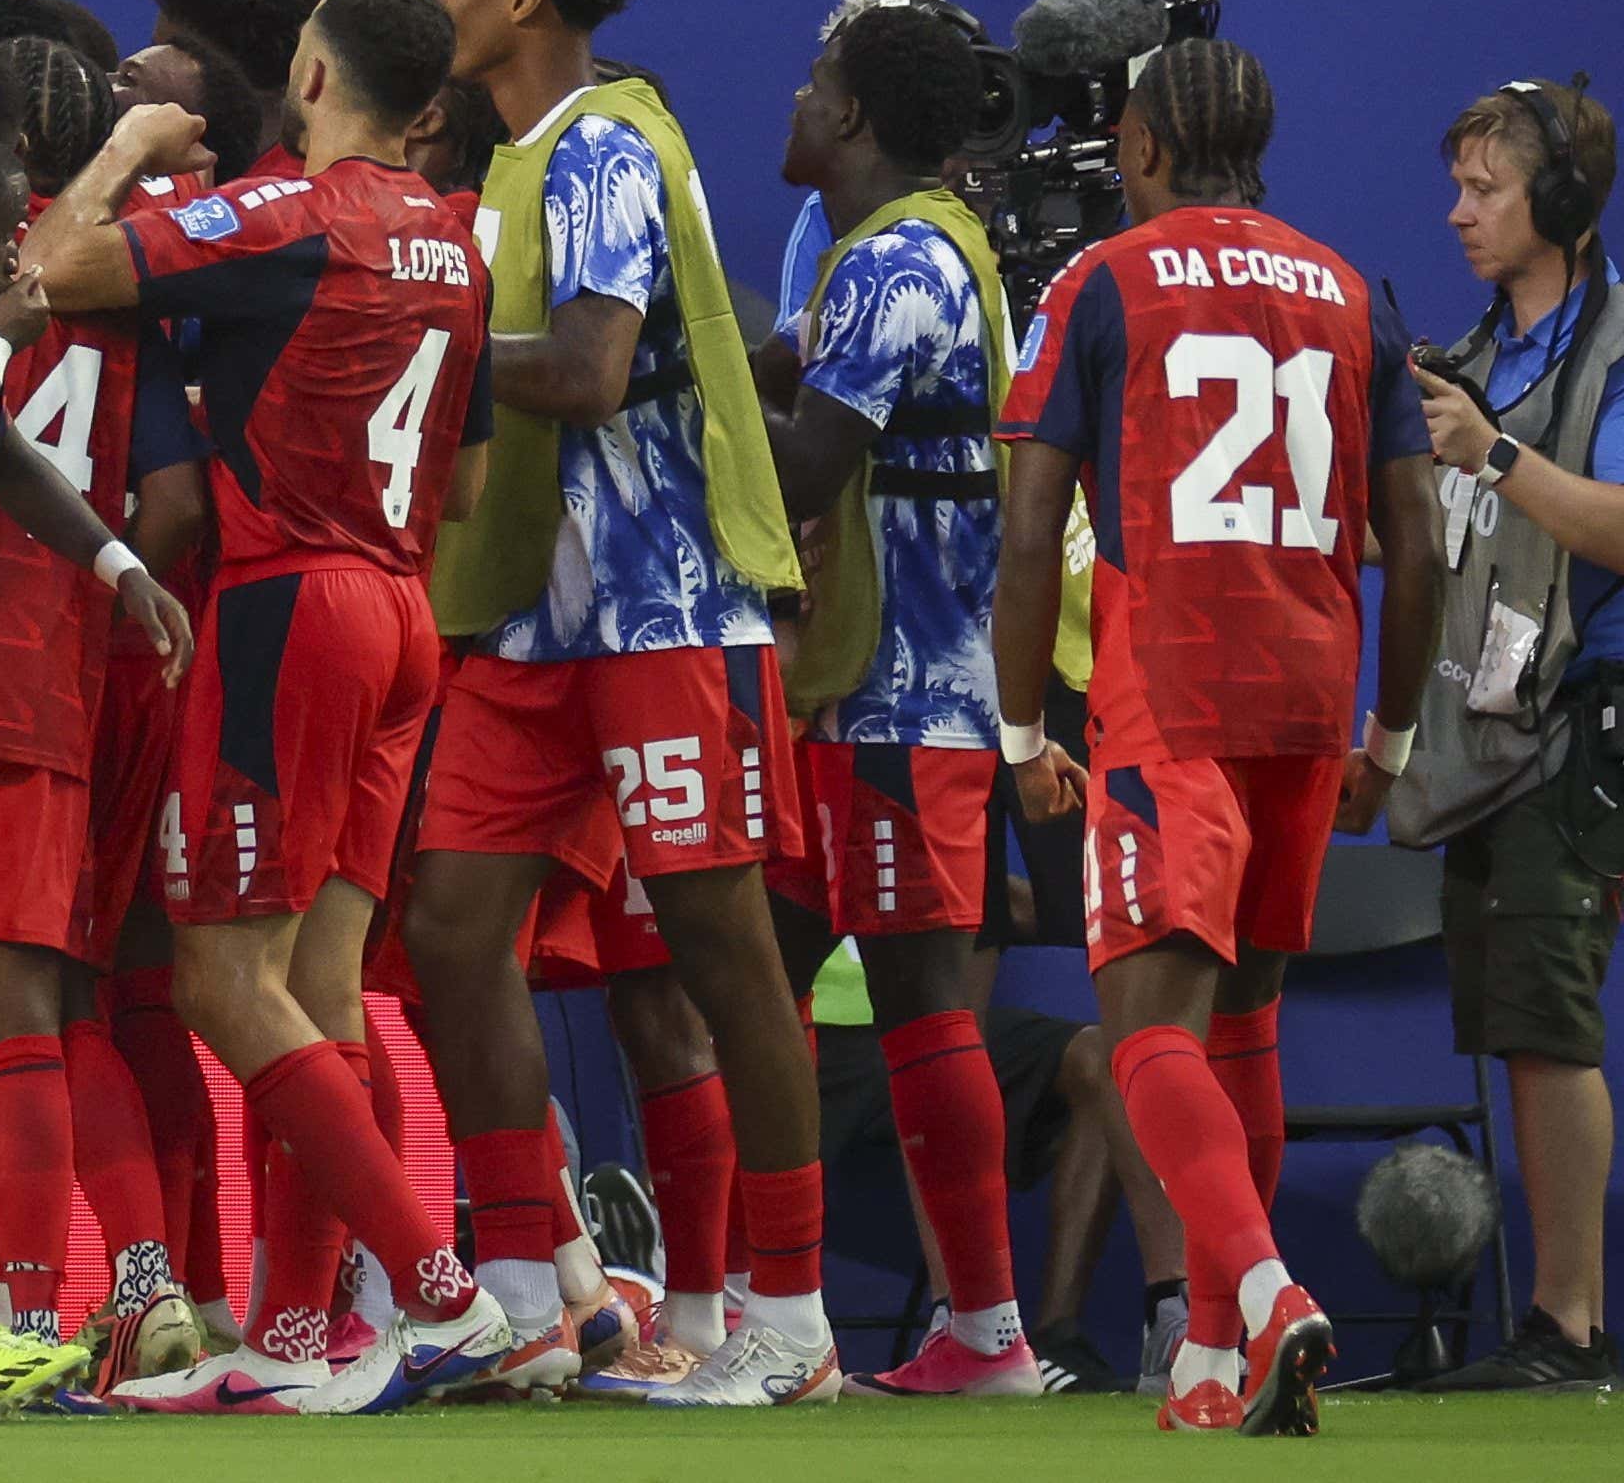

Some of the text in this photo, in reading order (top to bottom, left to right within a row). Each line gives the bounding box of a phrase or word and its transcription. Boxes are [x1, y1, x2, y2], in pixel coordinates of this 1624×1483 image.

[388, 238, 470, 287] LOPES
[1148, 248, 1346, 306] DA COSTA
[367, 328, 451, 529] 4
[1164, 333, 1339, 555] 21
[603, 736, 705, 828] 25
[652, 822, 707, 845] capelli
